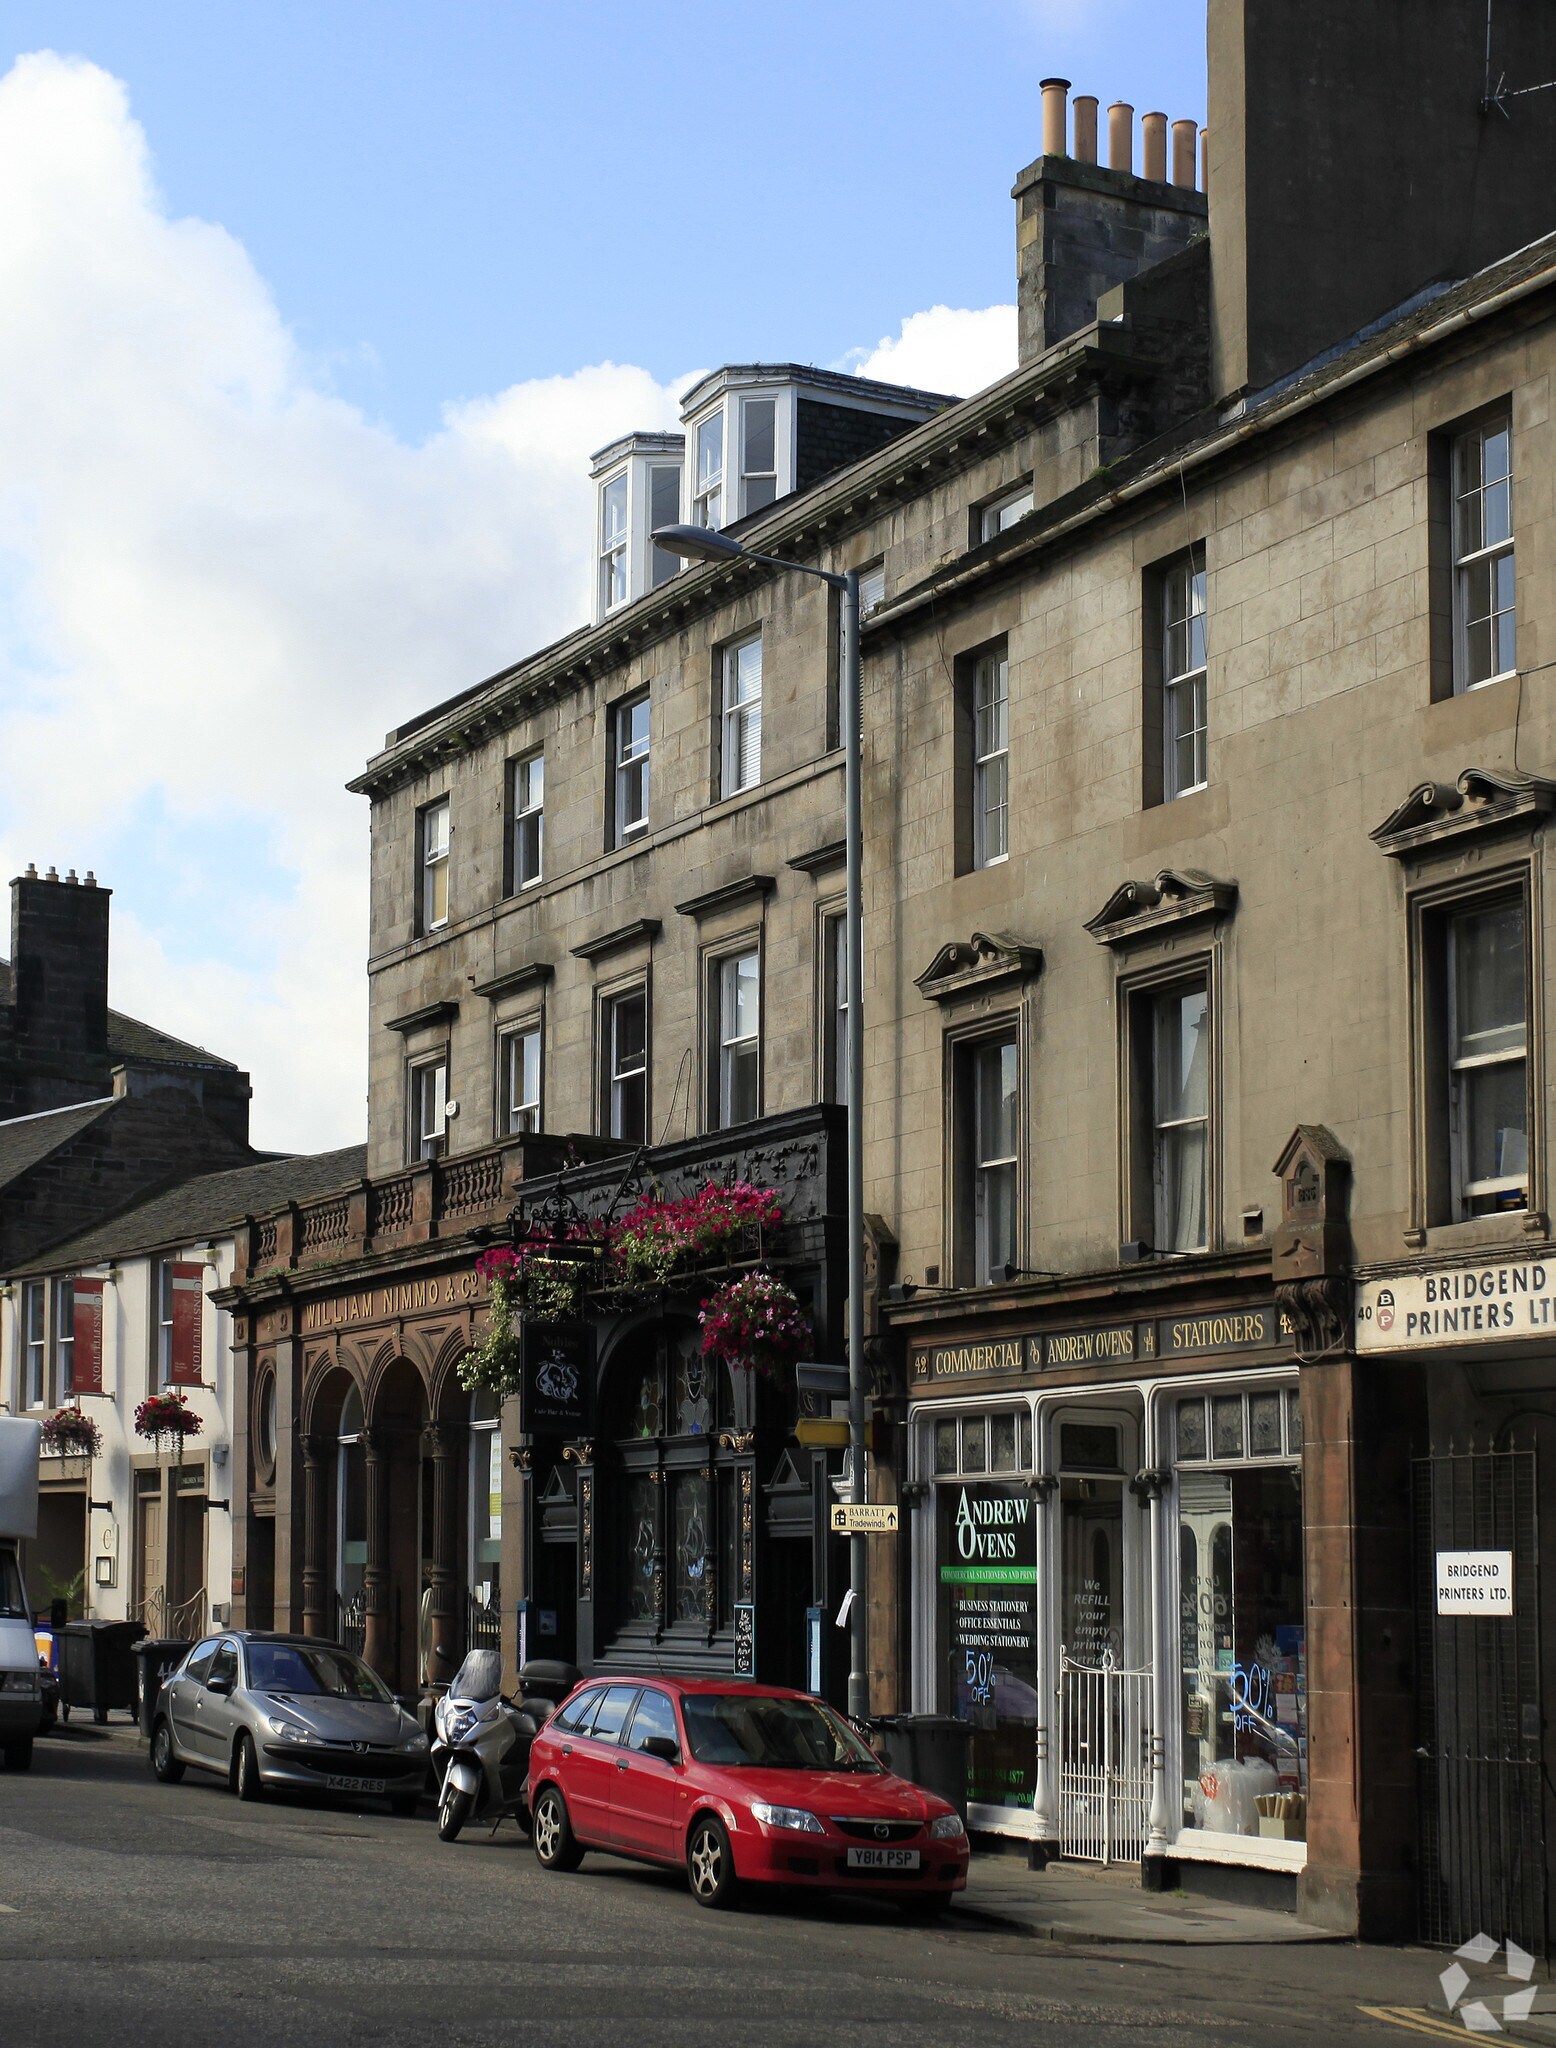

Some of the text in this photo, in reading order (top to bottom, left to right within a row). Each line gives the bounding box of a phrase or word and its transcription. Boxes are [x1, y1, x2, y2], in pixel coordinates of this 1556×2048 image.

[1426, 1265, 1546, 1303] BRIDGEND
[306, 1292, 374, 1328] WILLIAM
[383, 1279, 439, 1314] NIMMO
[445, 1276, 455, 1302] &
[1358, 1305, 1372, 1321] 40
[1407, 1297, 1556, 1336] PRINTERS LT
[193, 1281, 202, 1374] CONSTITUTION
[914, 1356, 927, 1374] 42
[935, 1342, 1022, 1375] COMMERCIAL
[1047, 1333, 1094, 1363] ANDREW
[1095, 1329, 1133, 1358] OVENS
[1172, 1313, 1264, 1349] STATIONERS
[849, 1508, 886, 1516] BARRATT
[955, 1486, 1029, 1525] ANDREW
[849, 1519, 886, 1527] Tradewinds
[958, 1519, 1016, 1559] OVENS
[977, 1570, 1008, 1580] STATIONERS
[1447, 1564, 1499, 1577] BRIDGEND
[1084, 1579, 1100, 1590] We
[1074, 1594, 1111, 1606] REFILL
[1439, 1587, 1510, 1600] PRINTERS LTD.
[959, 1600, 1028, 1613] BUSINESS STATIONERY
[959, 1617, 1021, 1630] OFFICE ESSENTIALS
[1080, 1611, 1106, 1621] your
[1075, 1625, 1110, 1638] empty
[959, 1634, 1029, 1648] WEDDING STATIONERY
[1073, 1639, 1112, 1652] printer
[966, 1650, 996, 1690] 50%
[971, 1686, 991, 1706] OFF
[1229, 1663, 1273, 1719] 50%
[1235, 1714, 1258, 1734] OFF
[328, 1776, 384, 1791] X422 RES
[855, 1850, 912, 1866] Y814 PSP
